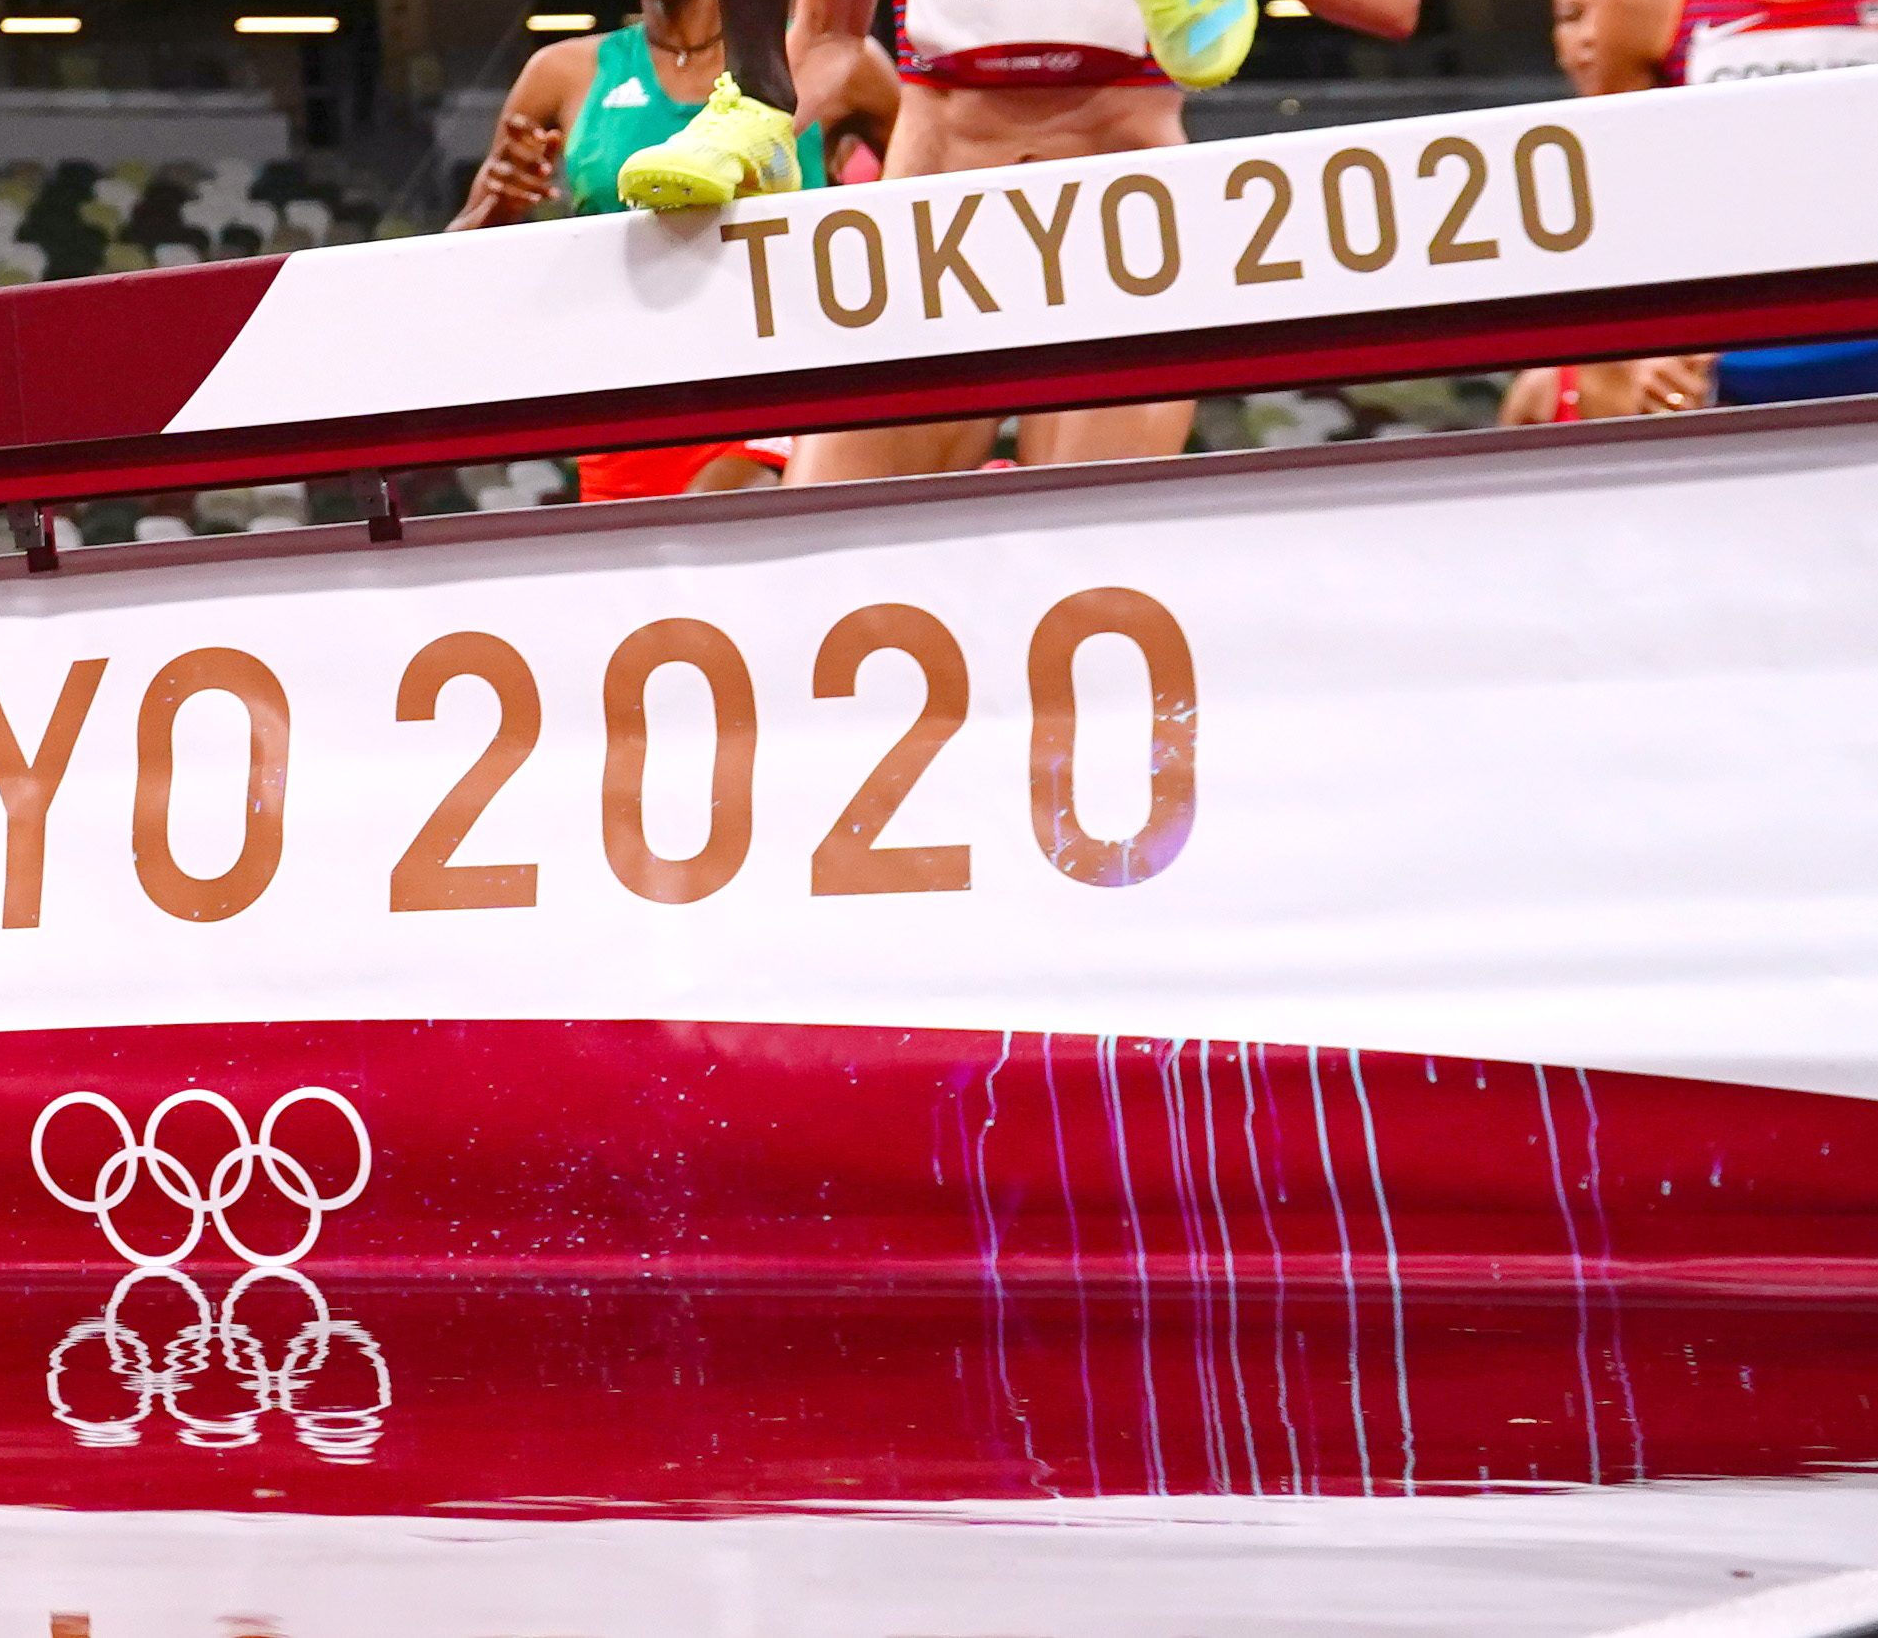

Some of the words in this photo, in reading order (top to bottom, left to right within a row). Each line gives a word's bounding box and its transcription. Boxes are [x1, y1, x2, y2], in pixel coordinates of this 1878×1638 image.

[719, 174, 1181, 338] TOKYO
[1224, 125, 1595, 285] 2020
[390, 587, 1197, 913] 2020
